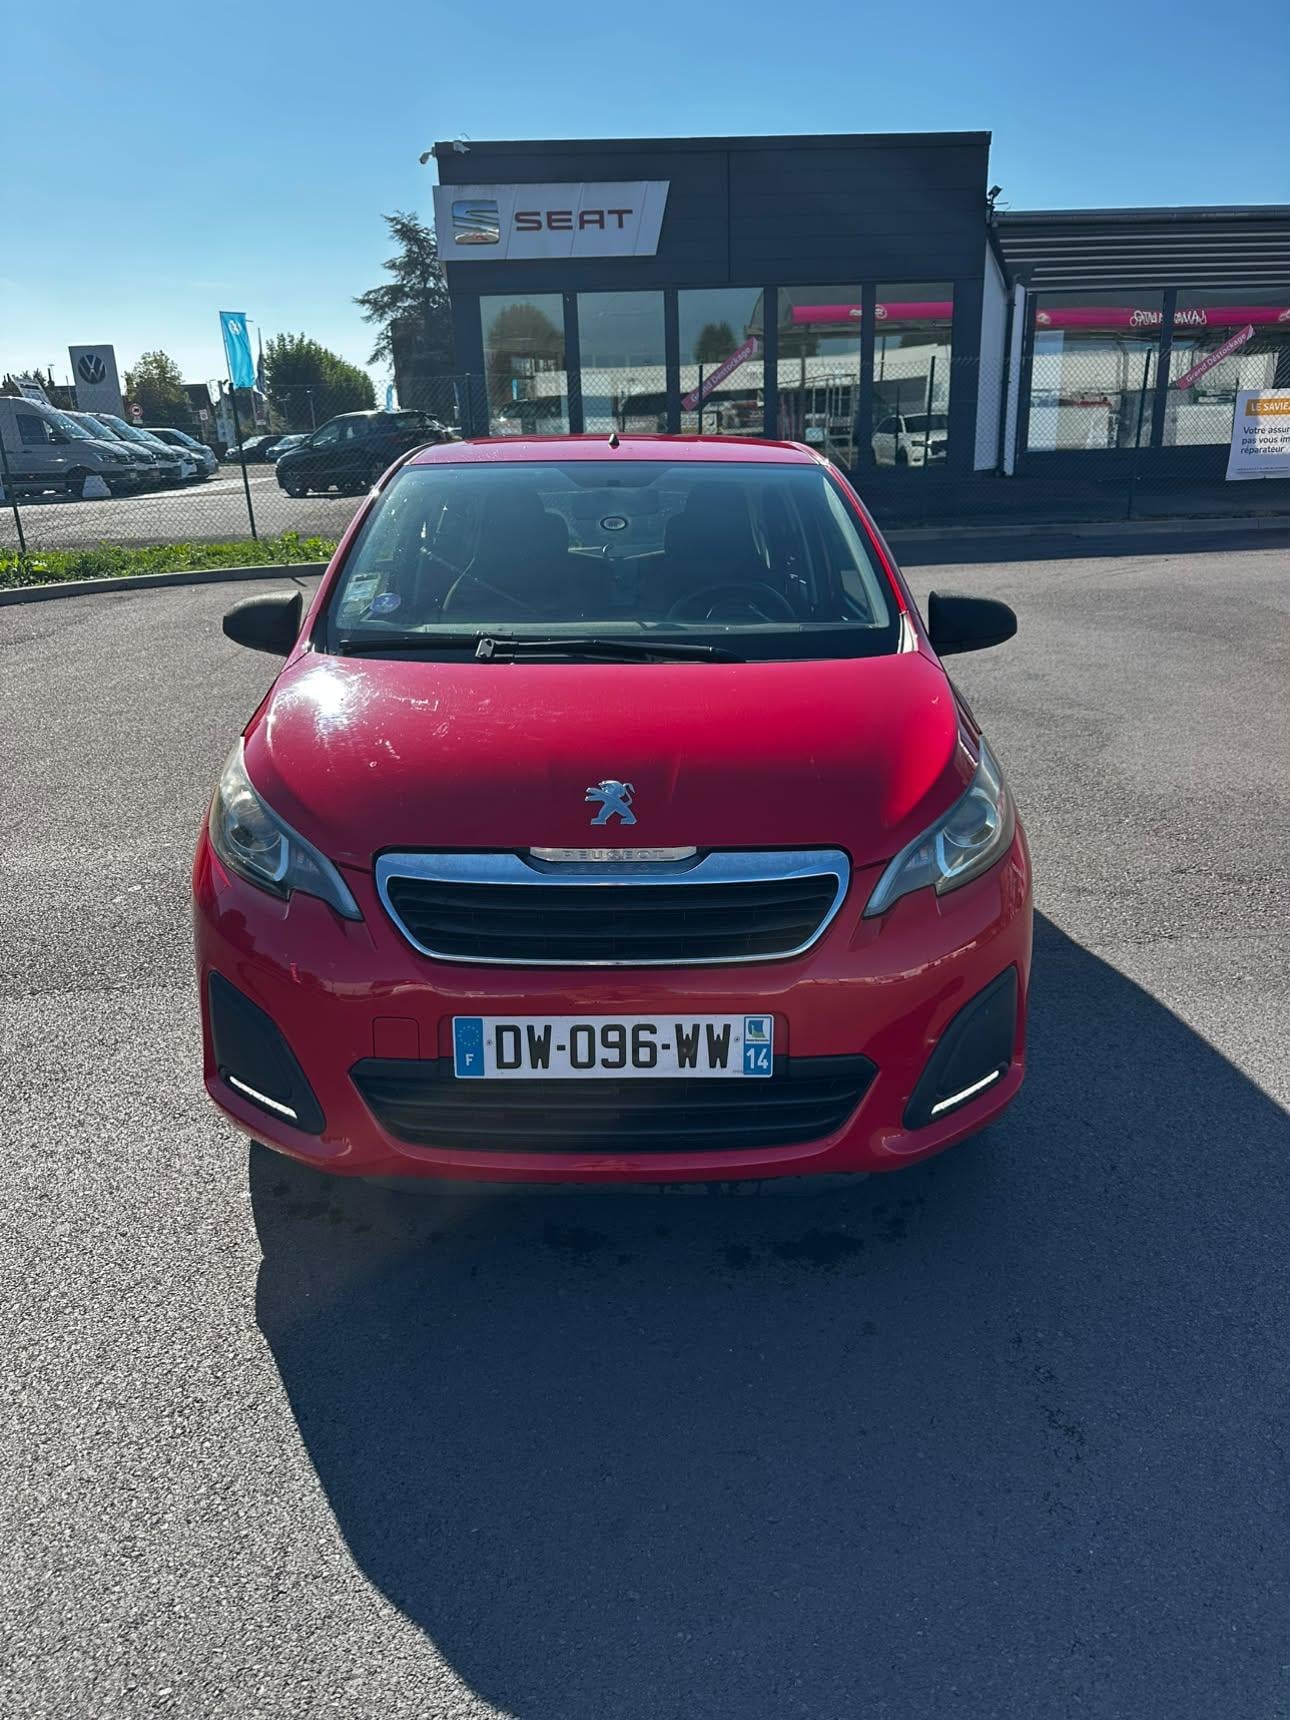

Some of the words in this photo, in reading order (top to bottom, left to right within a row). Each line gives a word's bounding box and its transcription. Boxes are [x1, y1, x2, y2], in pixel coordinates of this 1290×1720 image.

[514, 209, 634, 232] SEAT
[1186, 363, 1208, 382] Grand
[1251, 402, 1262, 412] LE
[1243, 426, 1266, 434] Votre
[1267, 426, 1290, 434] assur
[1241, 437, 1257, 446] pas
[1259, 436, 1278, 444] vous
[1240, 446, 1285, 455] réparateur
[495, 1023, 732, 1070] DW-096-WW
[465, 1053, 475, 1067] F
[745, 1047, 769, 1070] 14
